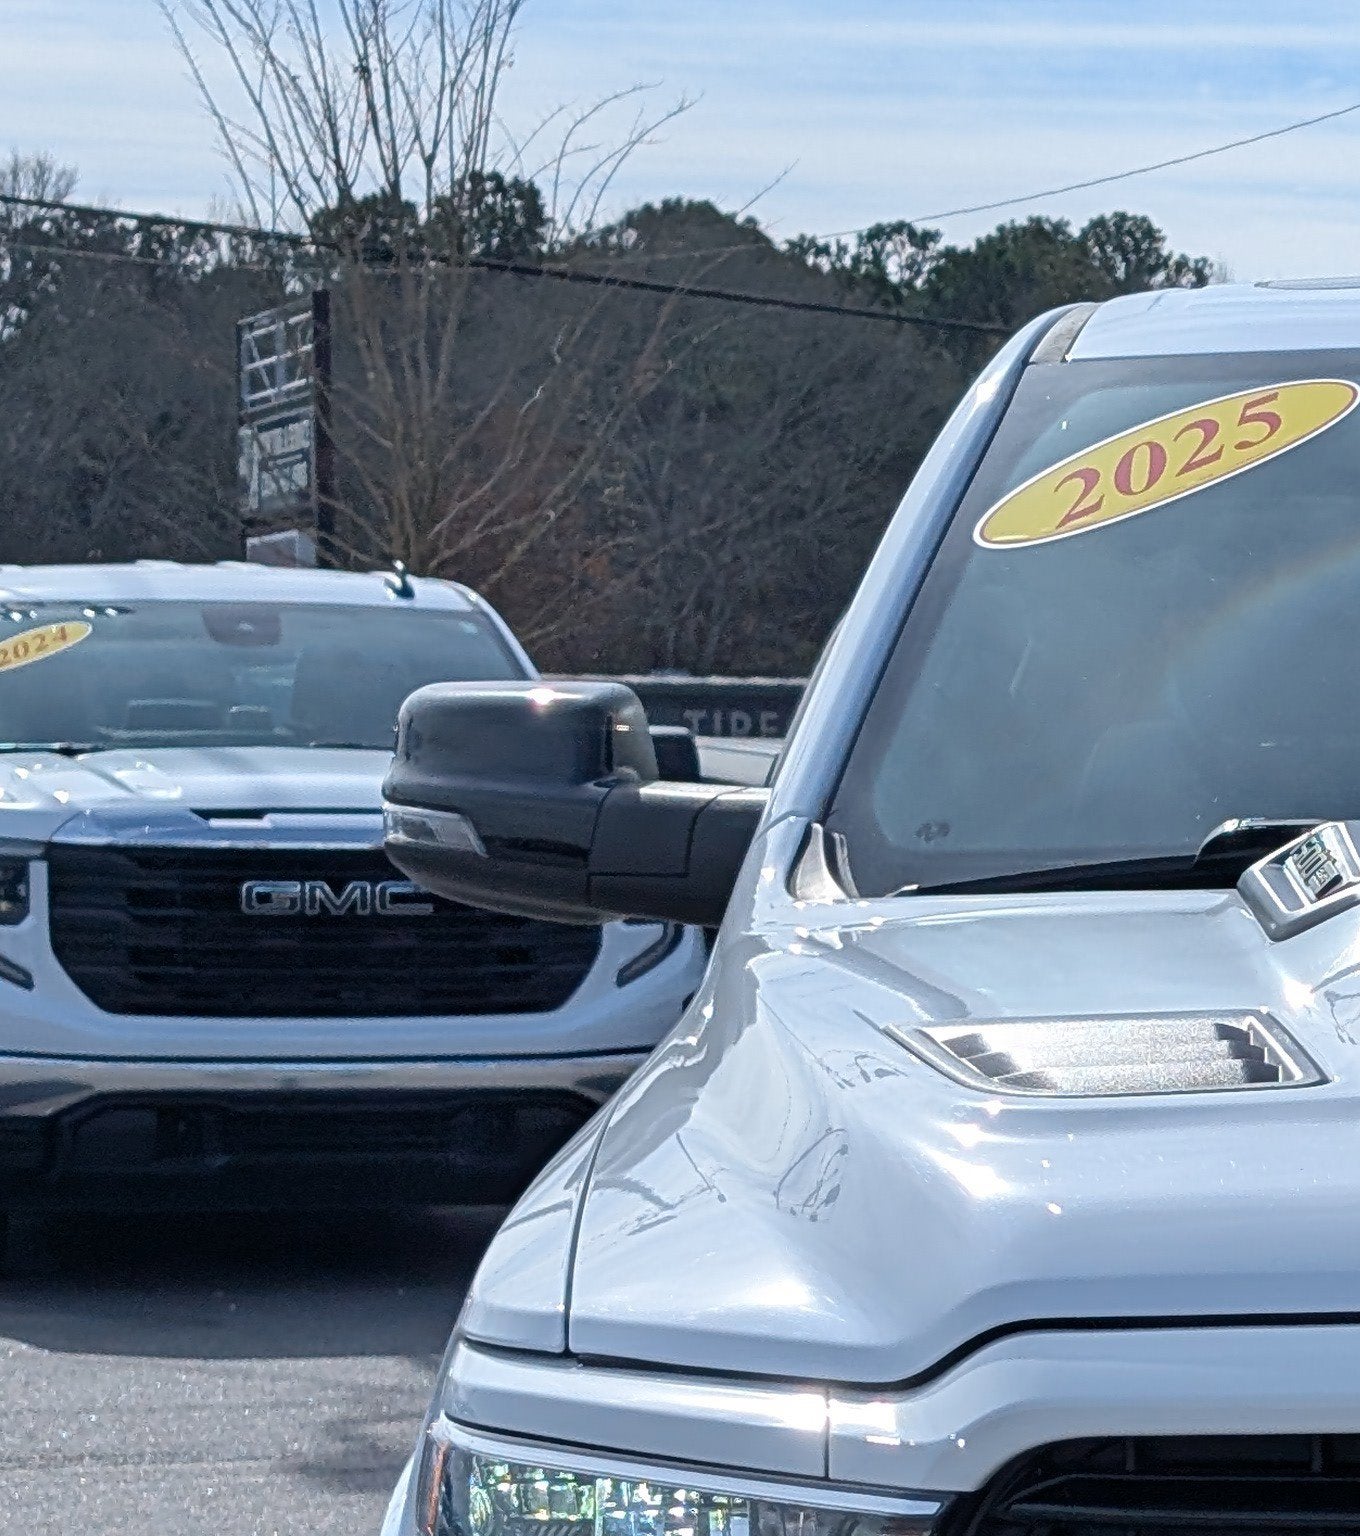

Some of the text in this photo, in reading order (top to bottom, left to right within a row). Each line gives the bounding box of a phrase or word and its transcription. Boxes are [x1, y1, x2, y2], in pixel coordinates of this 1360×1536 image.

[1053, 392, 1282, 530] 2025
[0, 625, 67, 667] 2024
[241, 880, 434, 916] GMC
